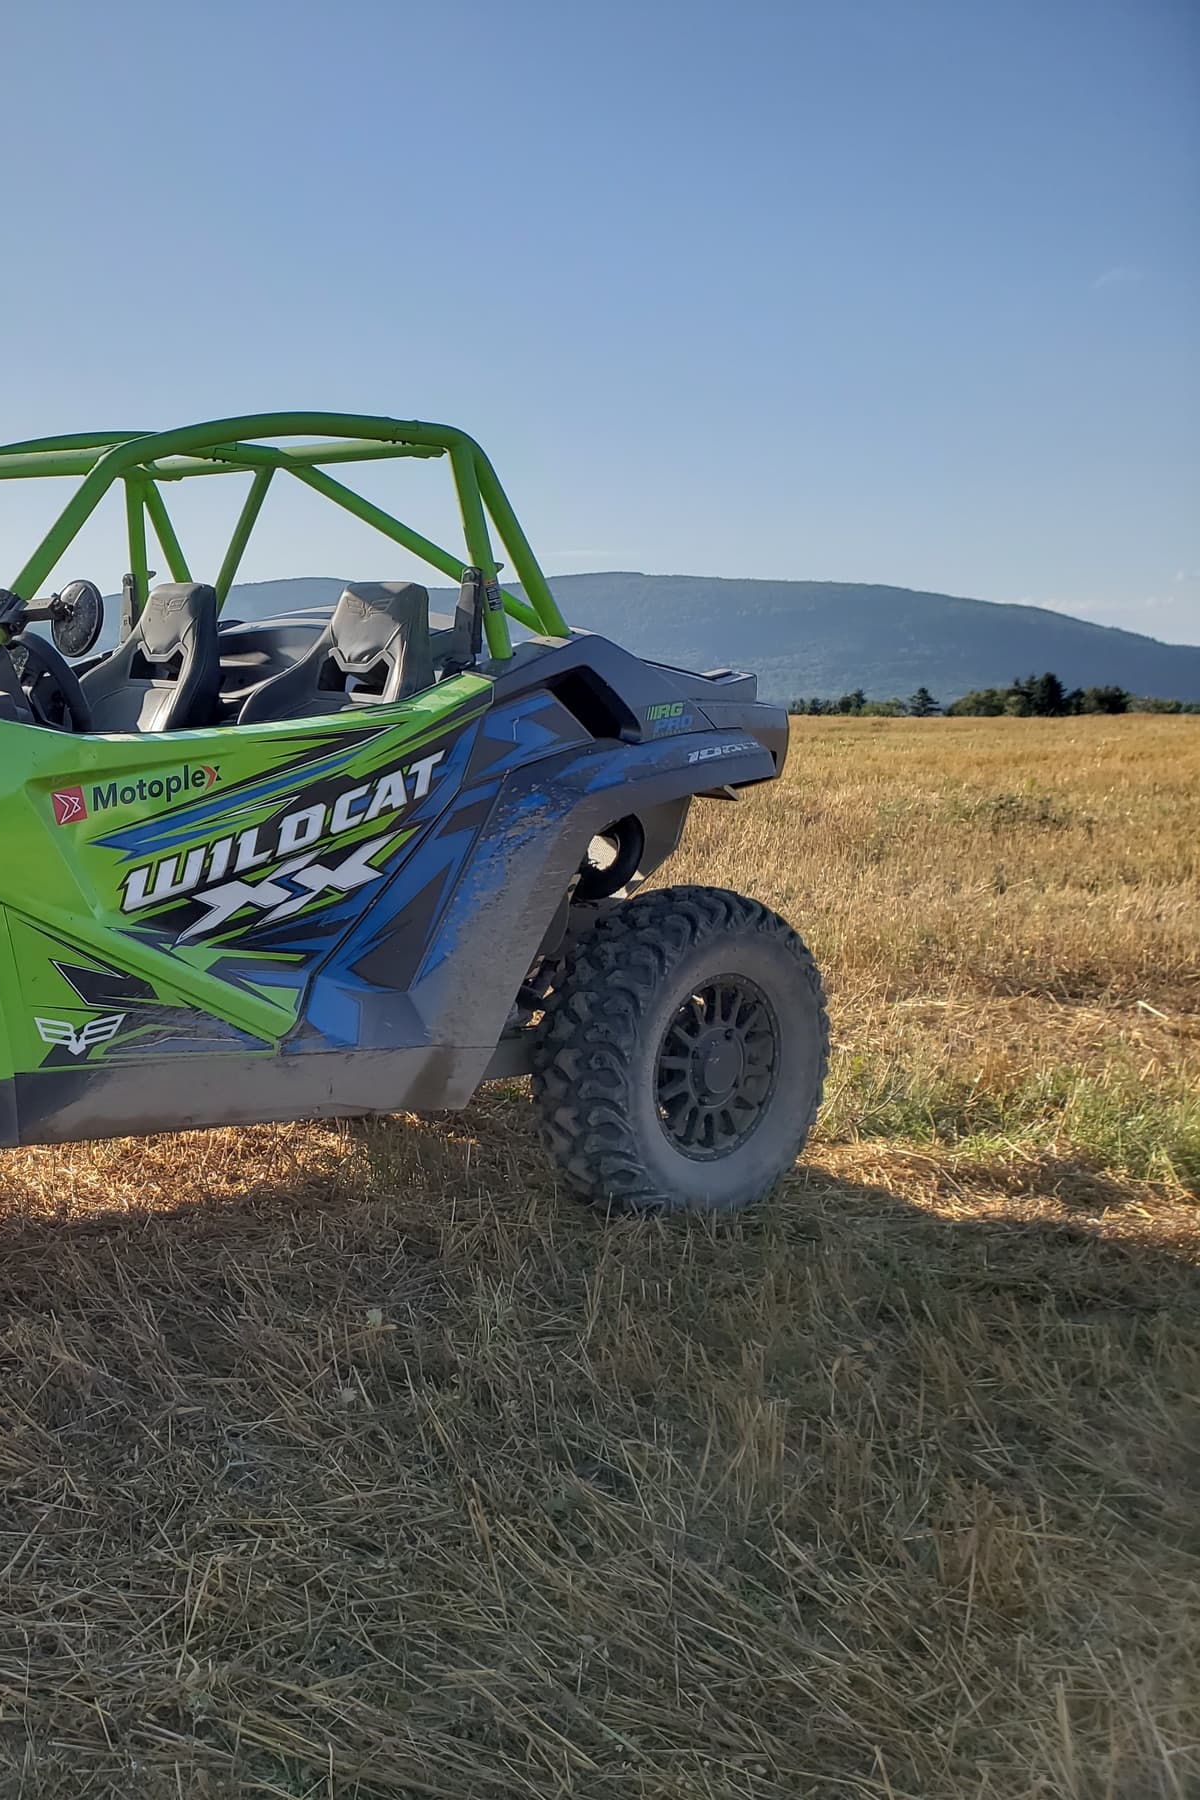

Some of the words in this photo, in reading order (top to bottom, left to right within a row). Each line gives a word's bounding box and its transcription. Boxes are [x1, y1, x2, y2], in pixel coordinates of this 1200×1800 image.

[653, 714, 693, 734] PRO
[93, 764, 222, 812] Motoplex
[116, 749, 446, 914] WILDCAT
[175, 828, 403, 944] XX
